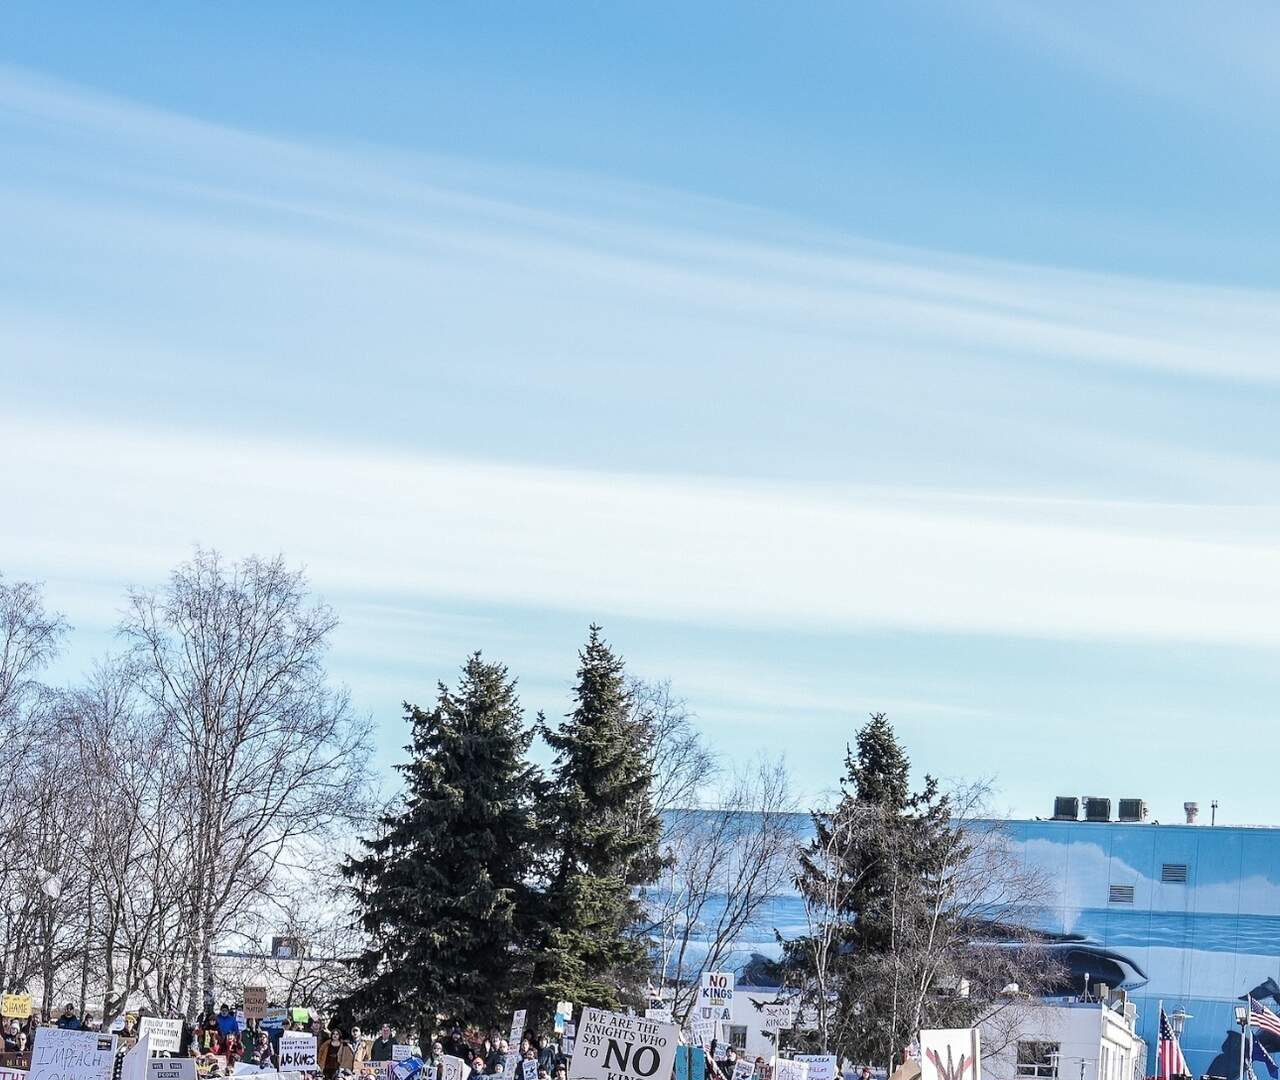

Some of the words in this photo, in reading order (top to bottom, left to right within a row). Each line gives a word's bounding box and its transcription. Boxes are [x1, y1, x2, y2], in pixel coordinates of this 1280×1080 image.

[709, 975, 727, 988] NO
[702, 987, 732, 999] KINGS
[3, 1001, 28, 1013] SHAME
[589, 1012, 606, 1024] WE
[610, 1017, 633, 1028] ARE
[638, 1021, 659, 1034] THE
[585, 1023, 635, 1042] KNIGHTS
[640, 1036, 667, 1047] WHO
[582, 1034, 603, 1045] SAY
[602, 1039, 660, 1076] NO
[584, 1047, 598, 1058] TO
